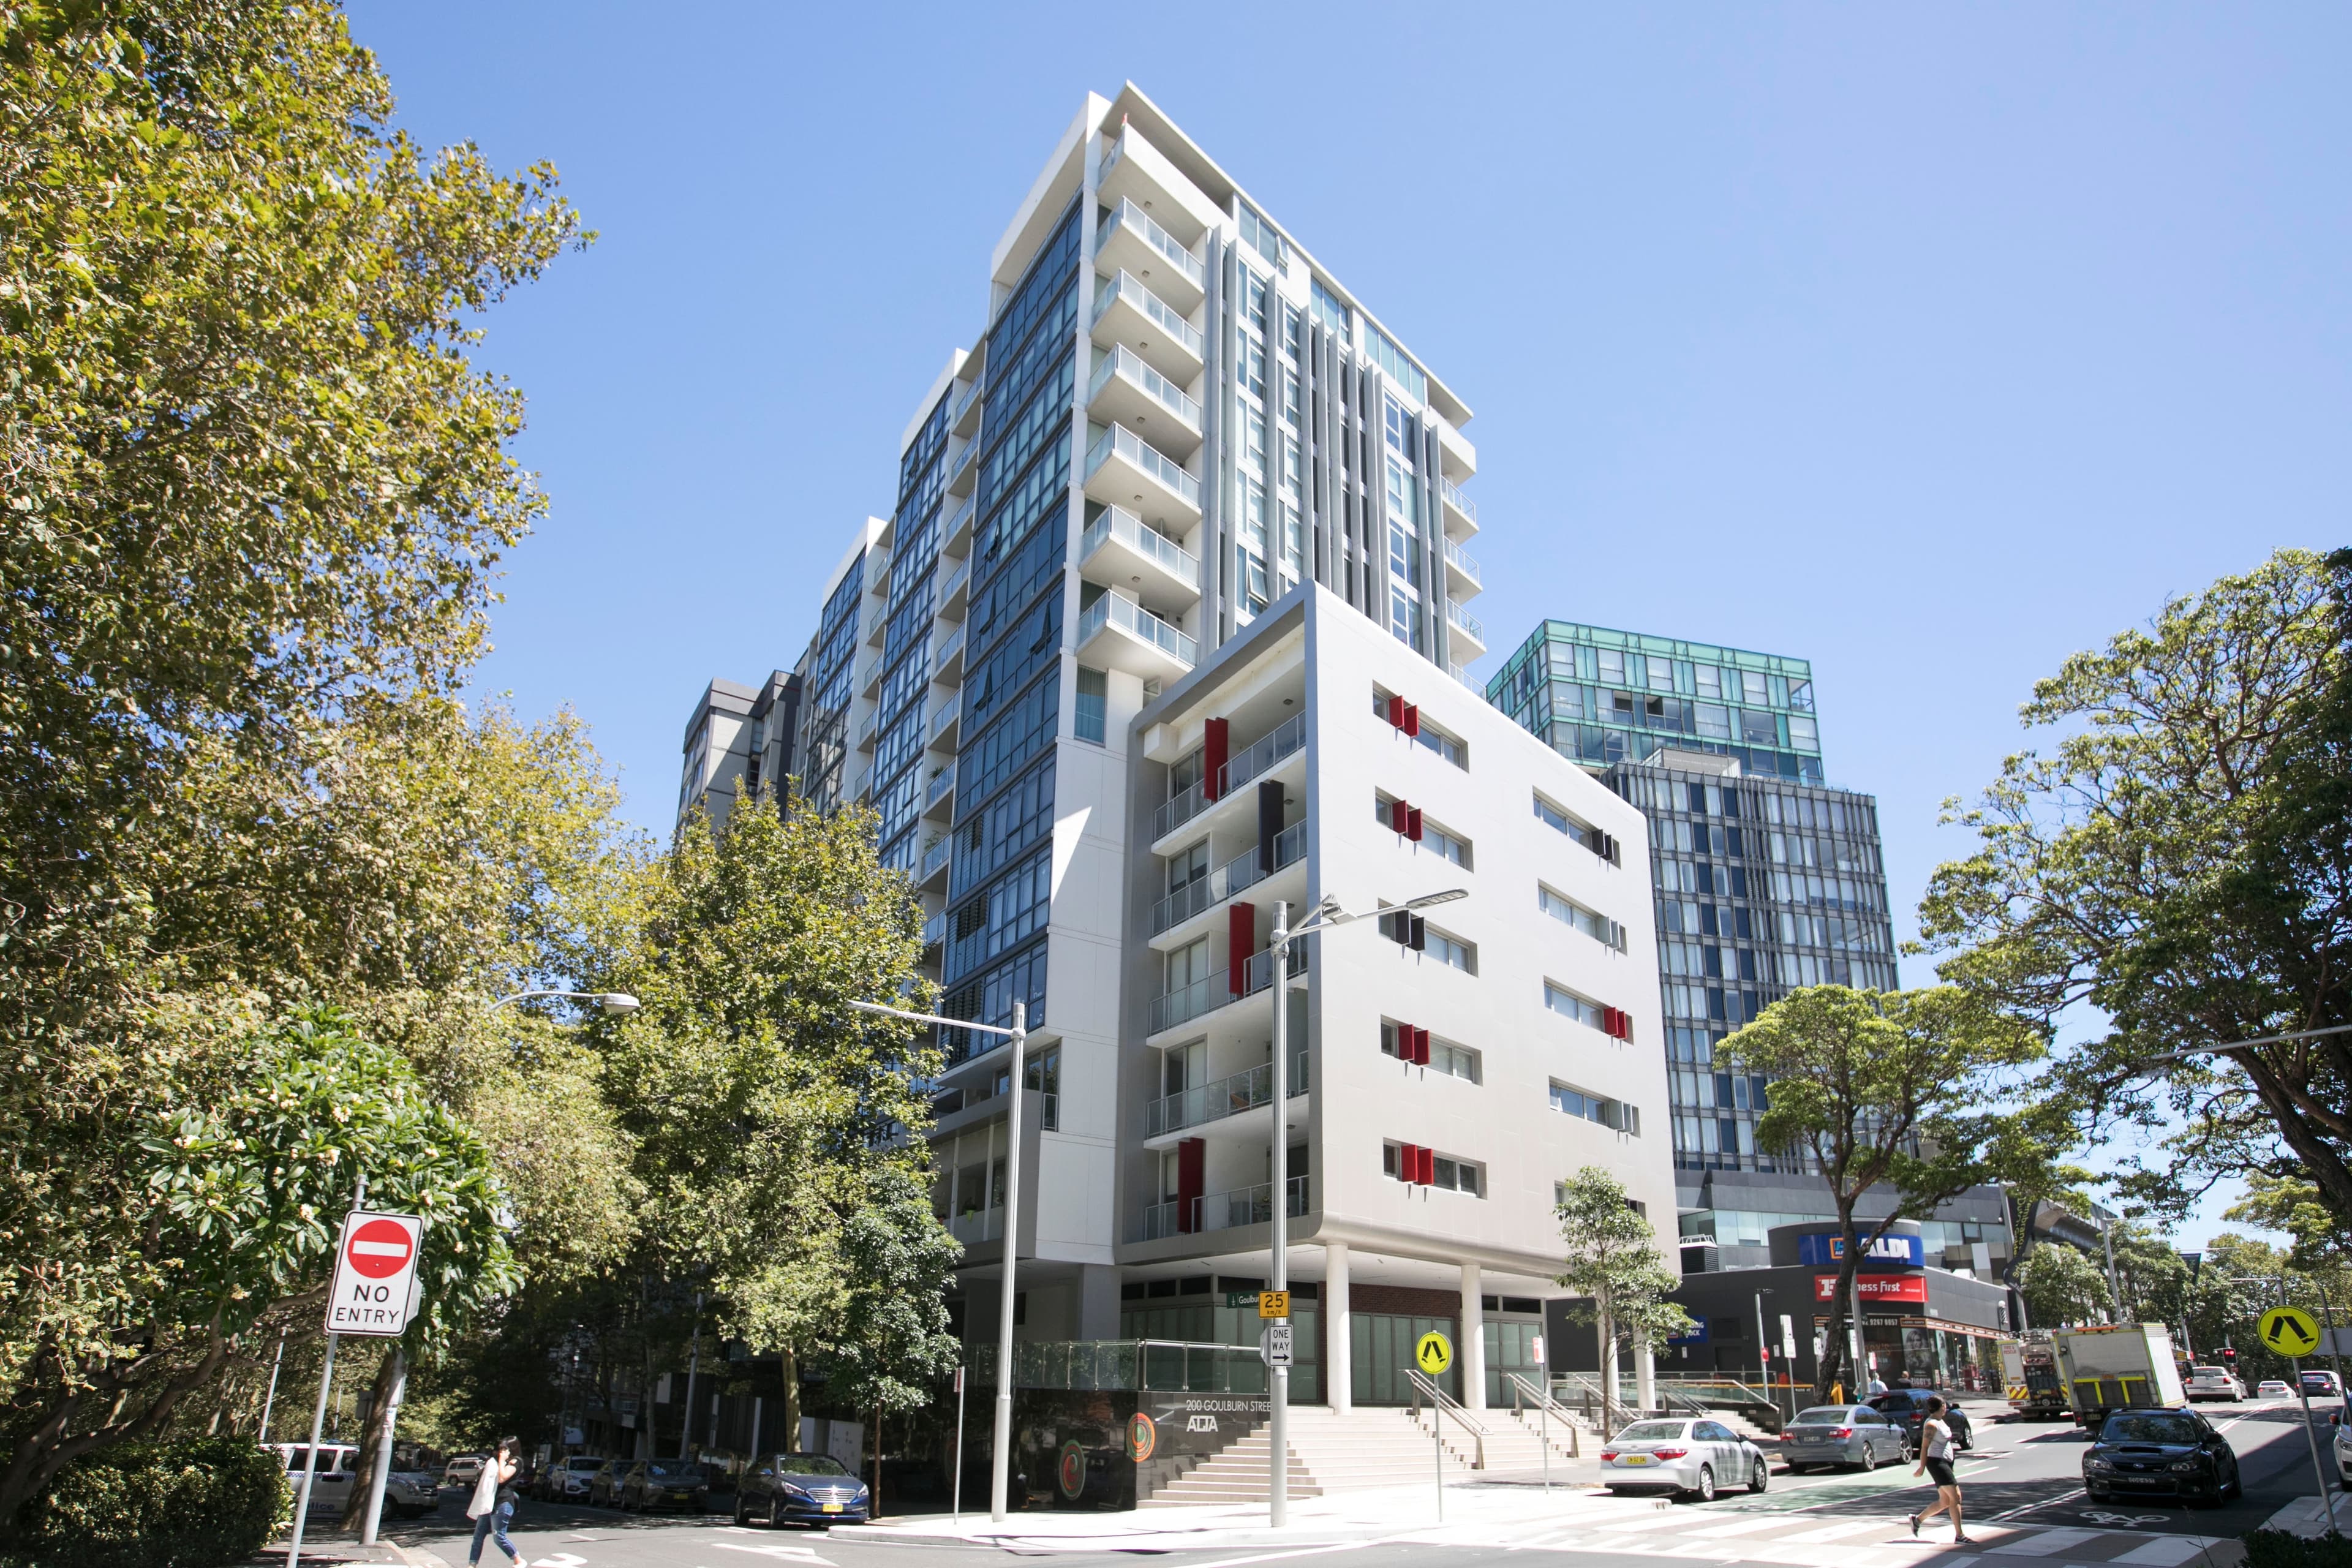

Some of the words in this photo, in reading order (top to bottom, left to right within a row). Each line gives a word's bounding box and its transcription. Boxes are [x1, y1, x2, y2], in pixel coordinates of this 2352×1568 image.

[1861, 1238, 1910, 1259] ALDI
[353, 1284, 390, 1303] NO
[1880, 1281, 1901, 1293] First
[1238, 1295, 1259, 1304] Goulbu
[1265, 1294, 1283, 1308] 25
[335, 1307, 400, 1324] ENTRY
[1273, 1329, 1289, 1338] ONE
[1272, 1341, 1290, 1351] WAY
[1186, 1400, 1202, 1411] 200
[1204, 1400, 1248, 1411] GOULBURN
[1250, 1401, 1271, 1412] STREE
[1186, 1415, 1219, 1432] ALTA
